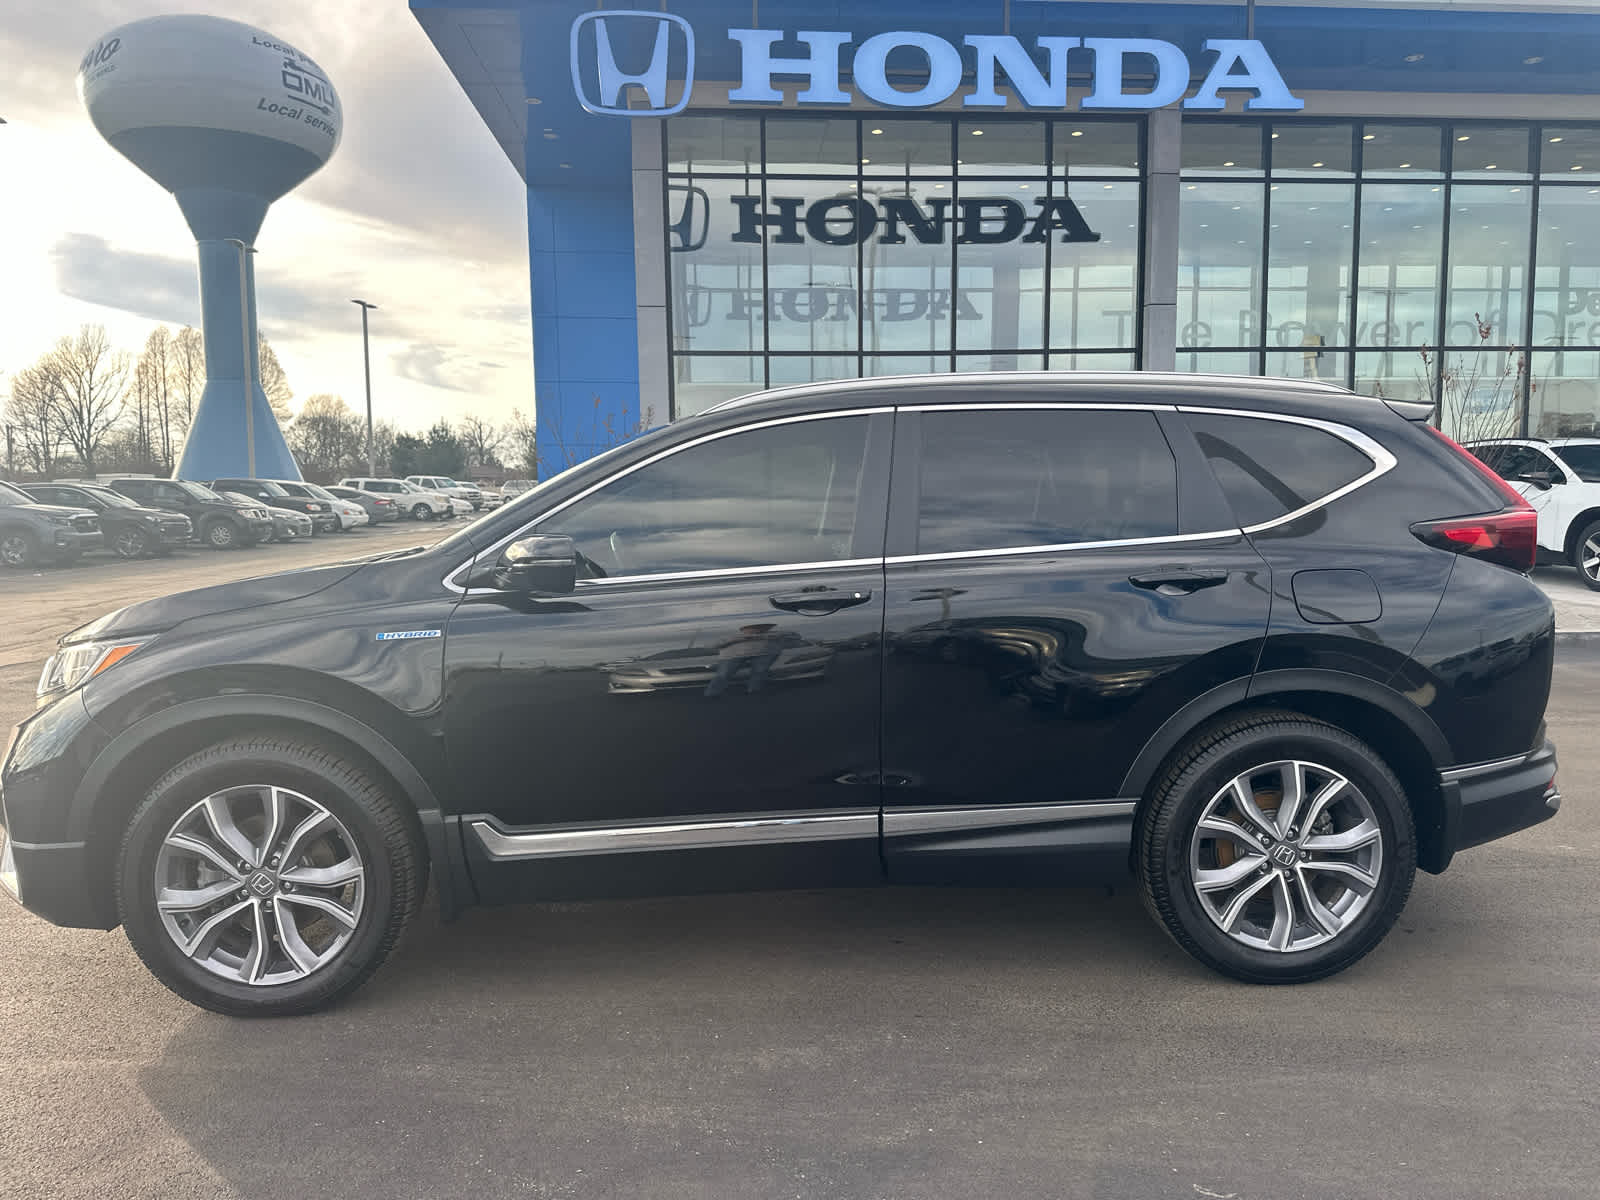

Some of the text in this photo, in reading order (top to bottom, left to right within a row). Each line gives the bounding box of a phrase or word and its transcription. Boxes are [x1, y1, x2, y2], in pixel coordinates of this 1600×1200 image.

[252, 36, 295, 56] Local
[728, 28, 1304, 111] HONDA
[257, 97, 303, 120] Local
[731, 195, 1101, 245] HONDA
[725, 287, 984, 322] HONDA
[1102, 310, 1212, 347] Te
[385, 630, 439, 639] HYBRID
